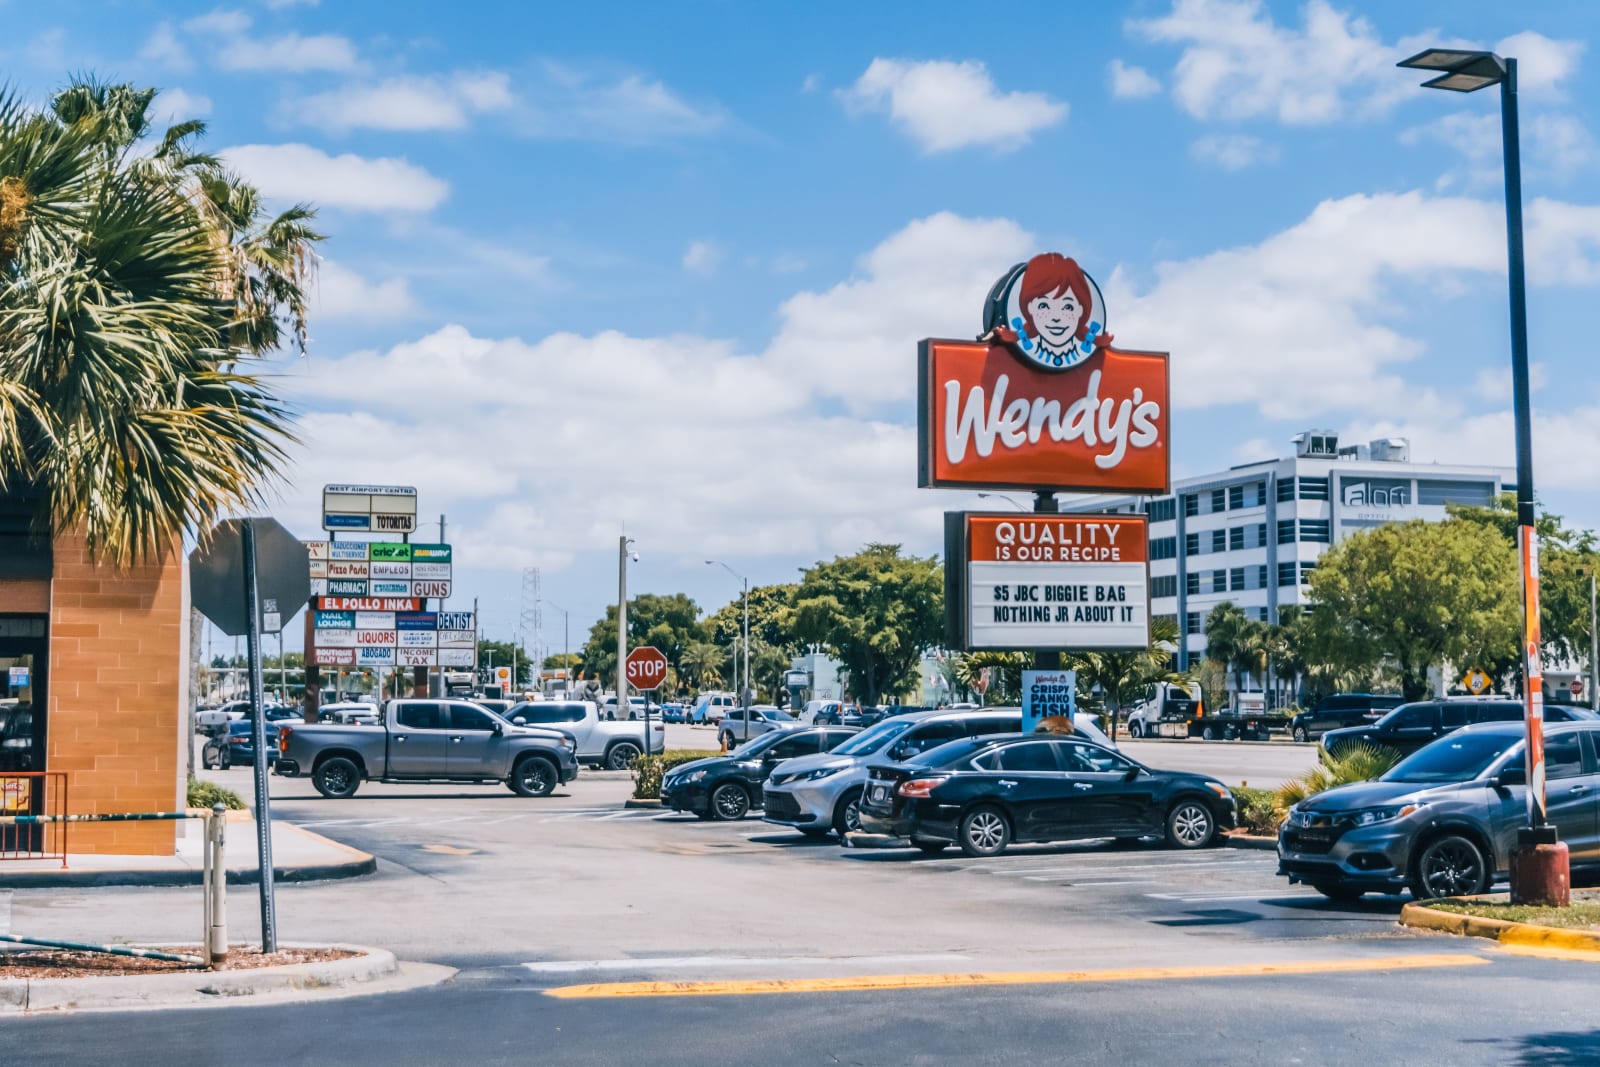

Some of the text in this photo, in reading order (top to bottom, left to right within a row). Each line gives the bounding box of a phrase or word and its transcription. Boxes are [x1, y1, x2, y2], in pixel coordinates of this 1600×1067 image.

[944, 369, 1161, 469] Wendy's
[1344, 482, 1406, 507] aloft
[376, 515, 412, 529] TOTORITAS
[995, 522, 1121, 546] QUALITY
[373, 547, 409, 557] cricket
[413, 549, 450, 557] SUBWAY
[996, 546, 1121, 561] IS OUR RECIPE
[329, 563, 348, 574] Pizza
[349, 563, 368, 575] Pasta
[373, 565, 409, 575] EMPLEOS
[329, 581, 367, 593] PHARMACY
[414, 582, 448, 597] GUNS
[994, 585, 1126, 601] $5 JBC BIGGIE BAG
[324, 597, 413, 611] EL POLLO INKA
[321, 612, 343, 620] NAIL
[994, 605, 1134, 623] NOTHING JR ABOUT IT
[317, 620, 352, 628] LOUNGE
[438, 612, 472, 629] DENTIST
[357, 631, 395, 644] LIQUORS
[361, 647, 391, 658] ABOGADO
[400, 648, 435, 656] INCOME
[405, 656, 428, 665] TAX
[628, 660, 664, 678] STOP
[1030, 684, 1070, 694] CRISPY
[1472, 680, 1483, 689] 40
[1030, 694, 1070, 703] PANKO
[1030, 703, 1070, 718] FISH
